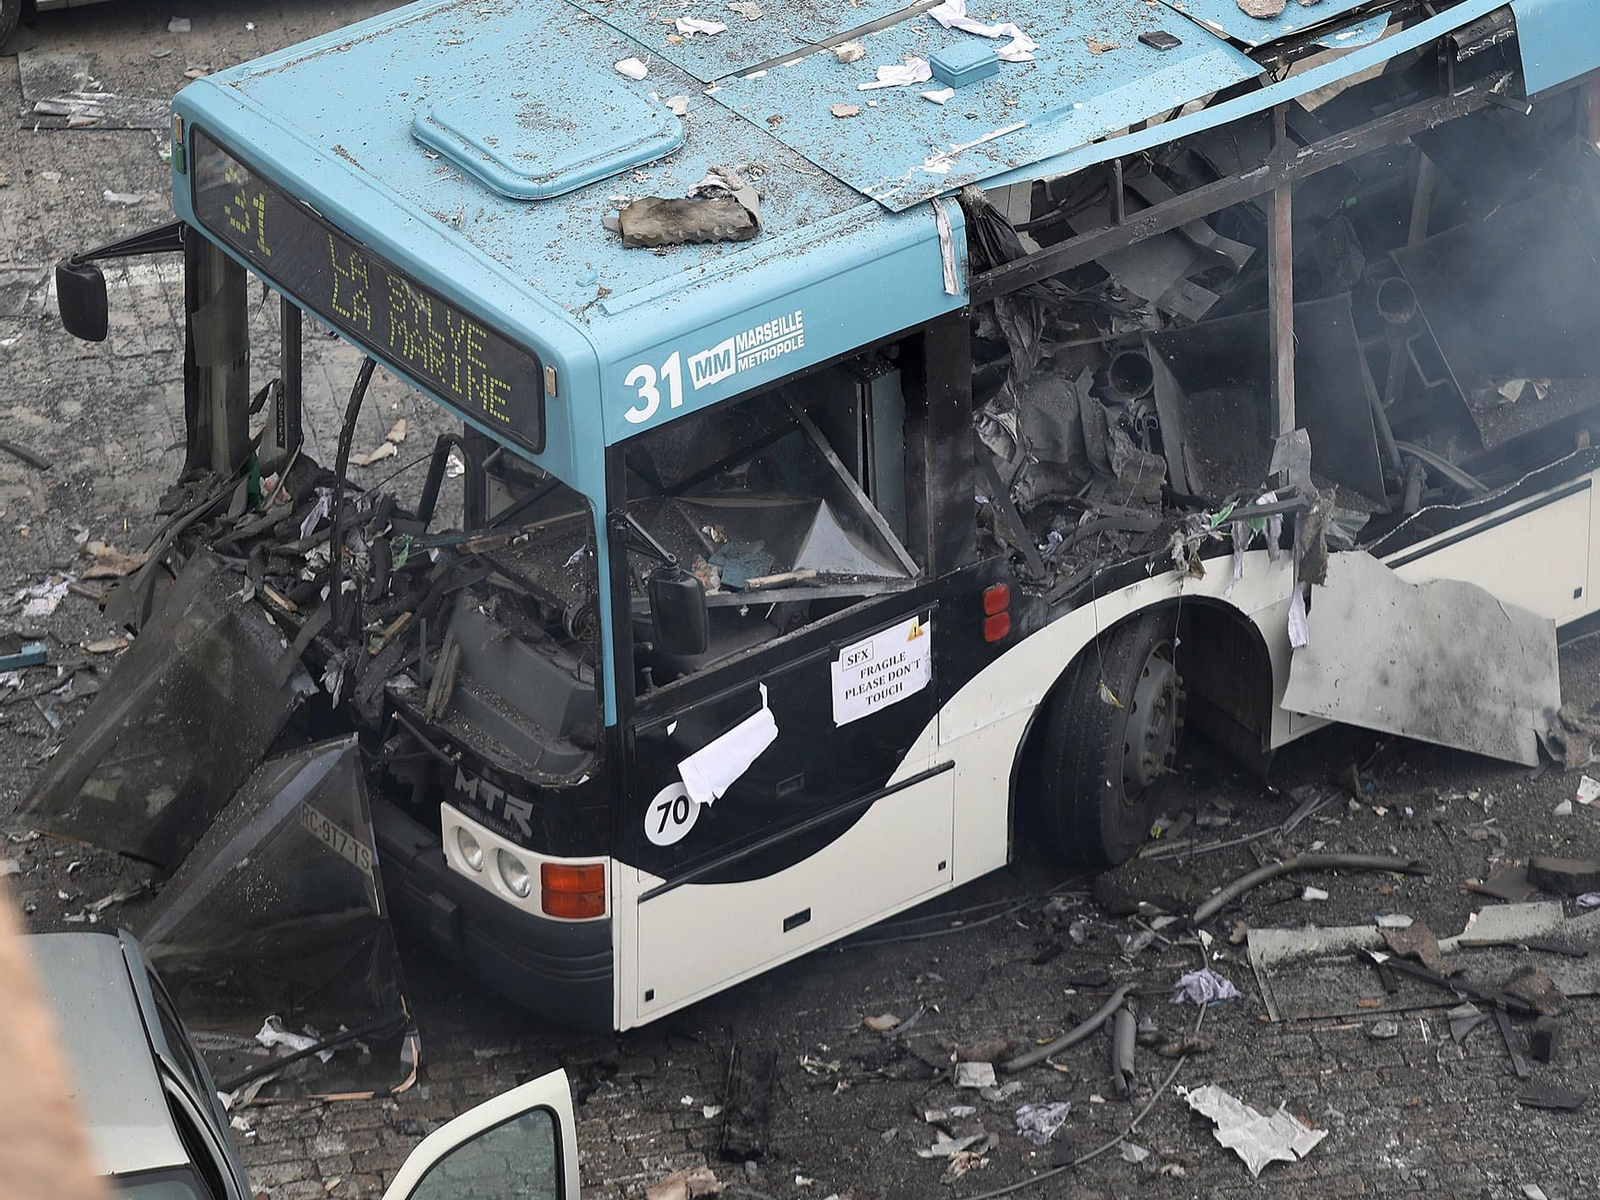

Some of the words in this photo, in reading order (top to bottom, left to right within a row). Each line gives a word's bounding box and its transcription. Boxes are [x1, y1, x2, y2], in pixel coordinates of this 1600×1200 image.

[328, 233, 370, 290] LA
[332, 272, 371, 331] LA
[389, 311, 512, 423] MARINE
[735, 309, 803, 353] MARSEILLE
[694, 349, 731, 382] MM
[738, 333, 805, 373] METROPOLE
[623, 350, 683, 424] 31
[847, 648, 869, 666] SFX
[860, 651, 906, 679] FRAGILE
[845, 676, 886, 700] PLEASE
[865, 682, 904, 706] TOUCH
[454, 764, 533, 839] MTR
[657, 794, 690, 834] 70
